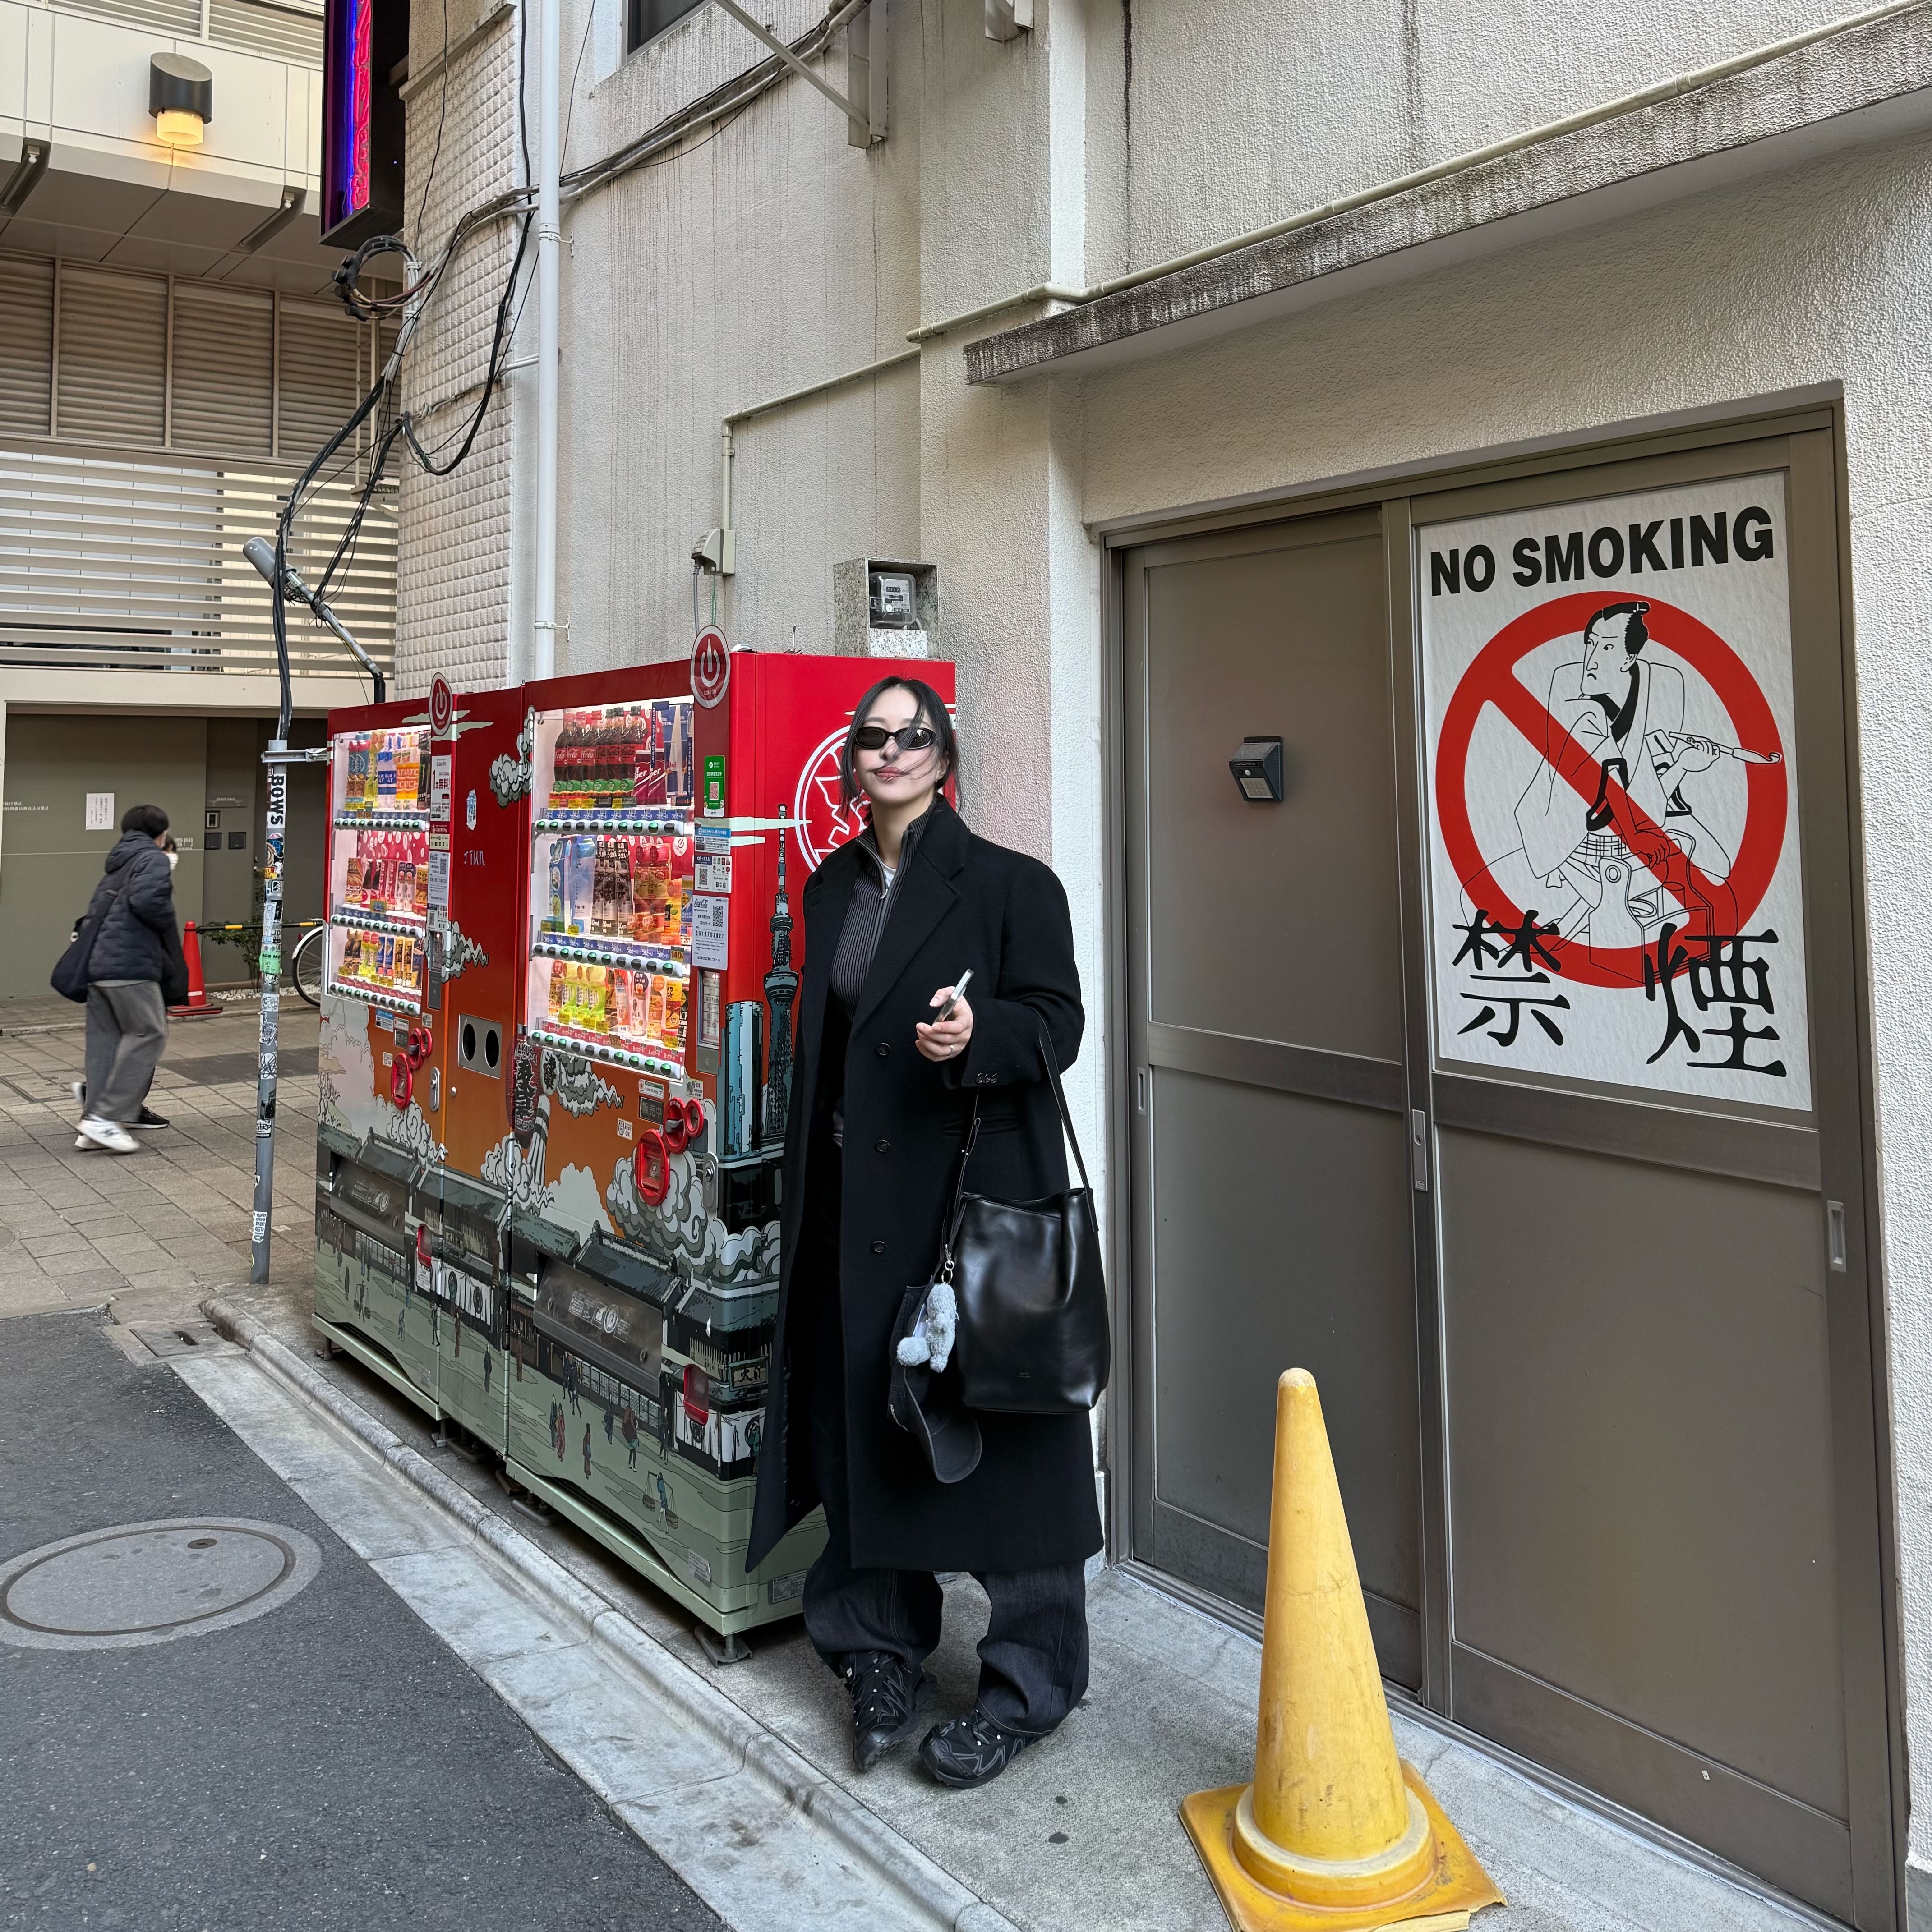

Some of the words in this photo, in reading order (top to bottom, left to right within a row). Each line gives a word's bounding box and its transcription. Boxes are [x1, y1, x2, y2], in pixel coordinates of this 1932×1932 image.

[1431, 545, 1495, 596] NO
[1512, 506, 1774, 587] SMOKING
[271, 775, 284, 825] BOWS
[1452, 909, 1787, 1077] 禁煙
[642, 1102, 662, 1118] 販売中
